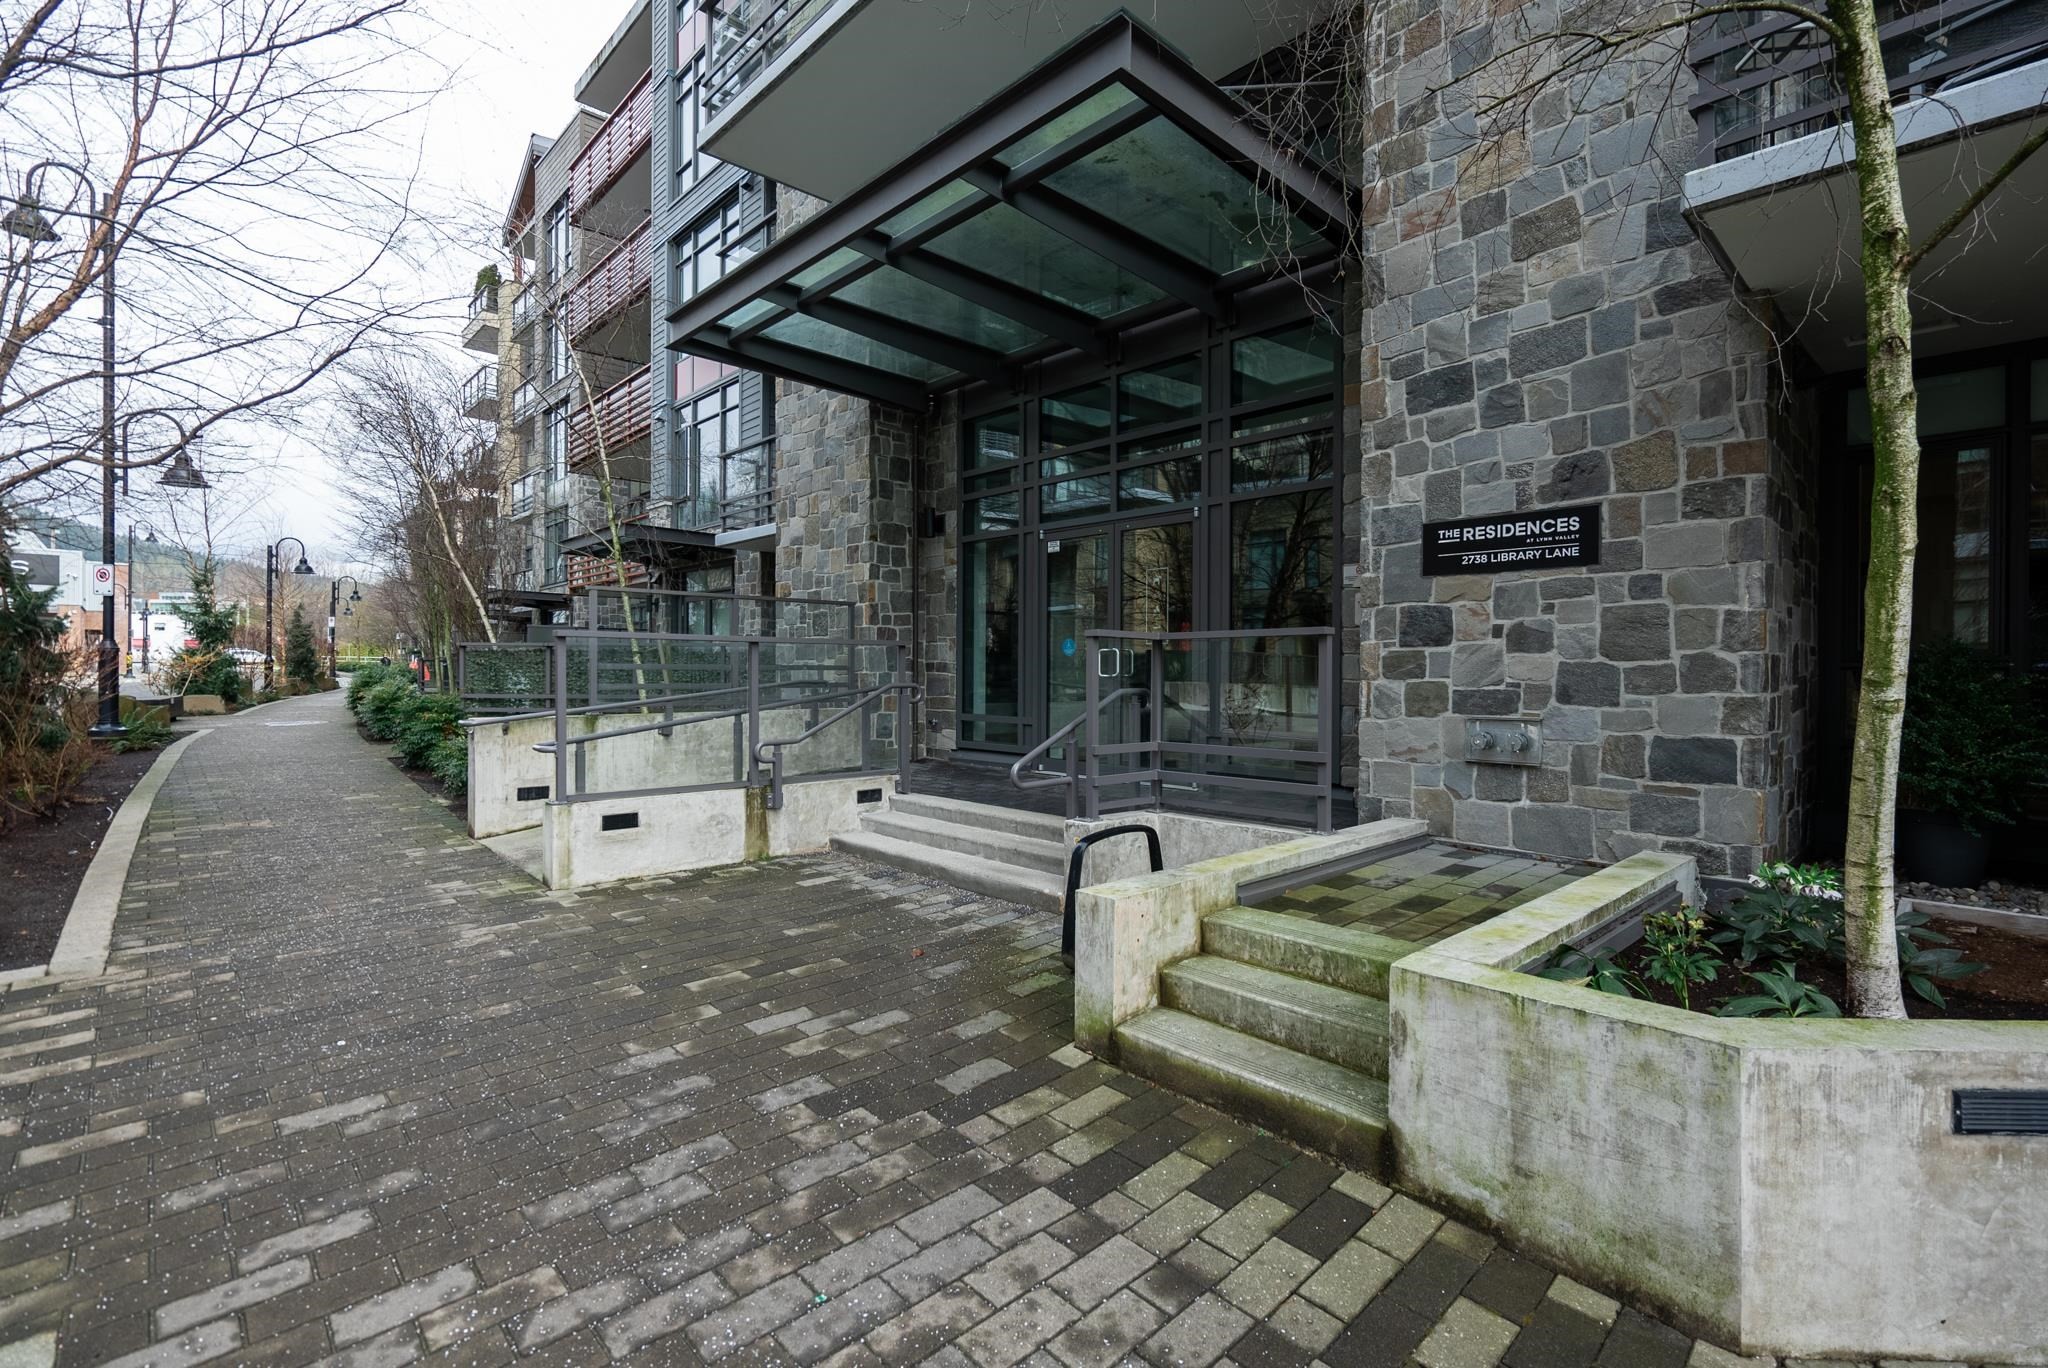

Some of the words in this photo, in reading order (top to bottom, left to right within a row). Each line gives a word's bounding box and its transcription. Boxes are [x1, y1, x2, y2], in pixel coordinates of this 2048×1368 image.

[1438, 528, 1460, 539] THE
[1463, 516, 1580, 541] RESIDENCES
[1461, 554, 1487, 565] 2738
[1490, 550, 1542, 563] LIBRARY
[1545, 547, 1580, 558] LANE
